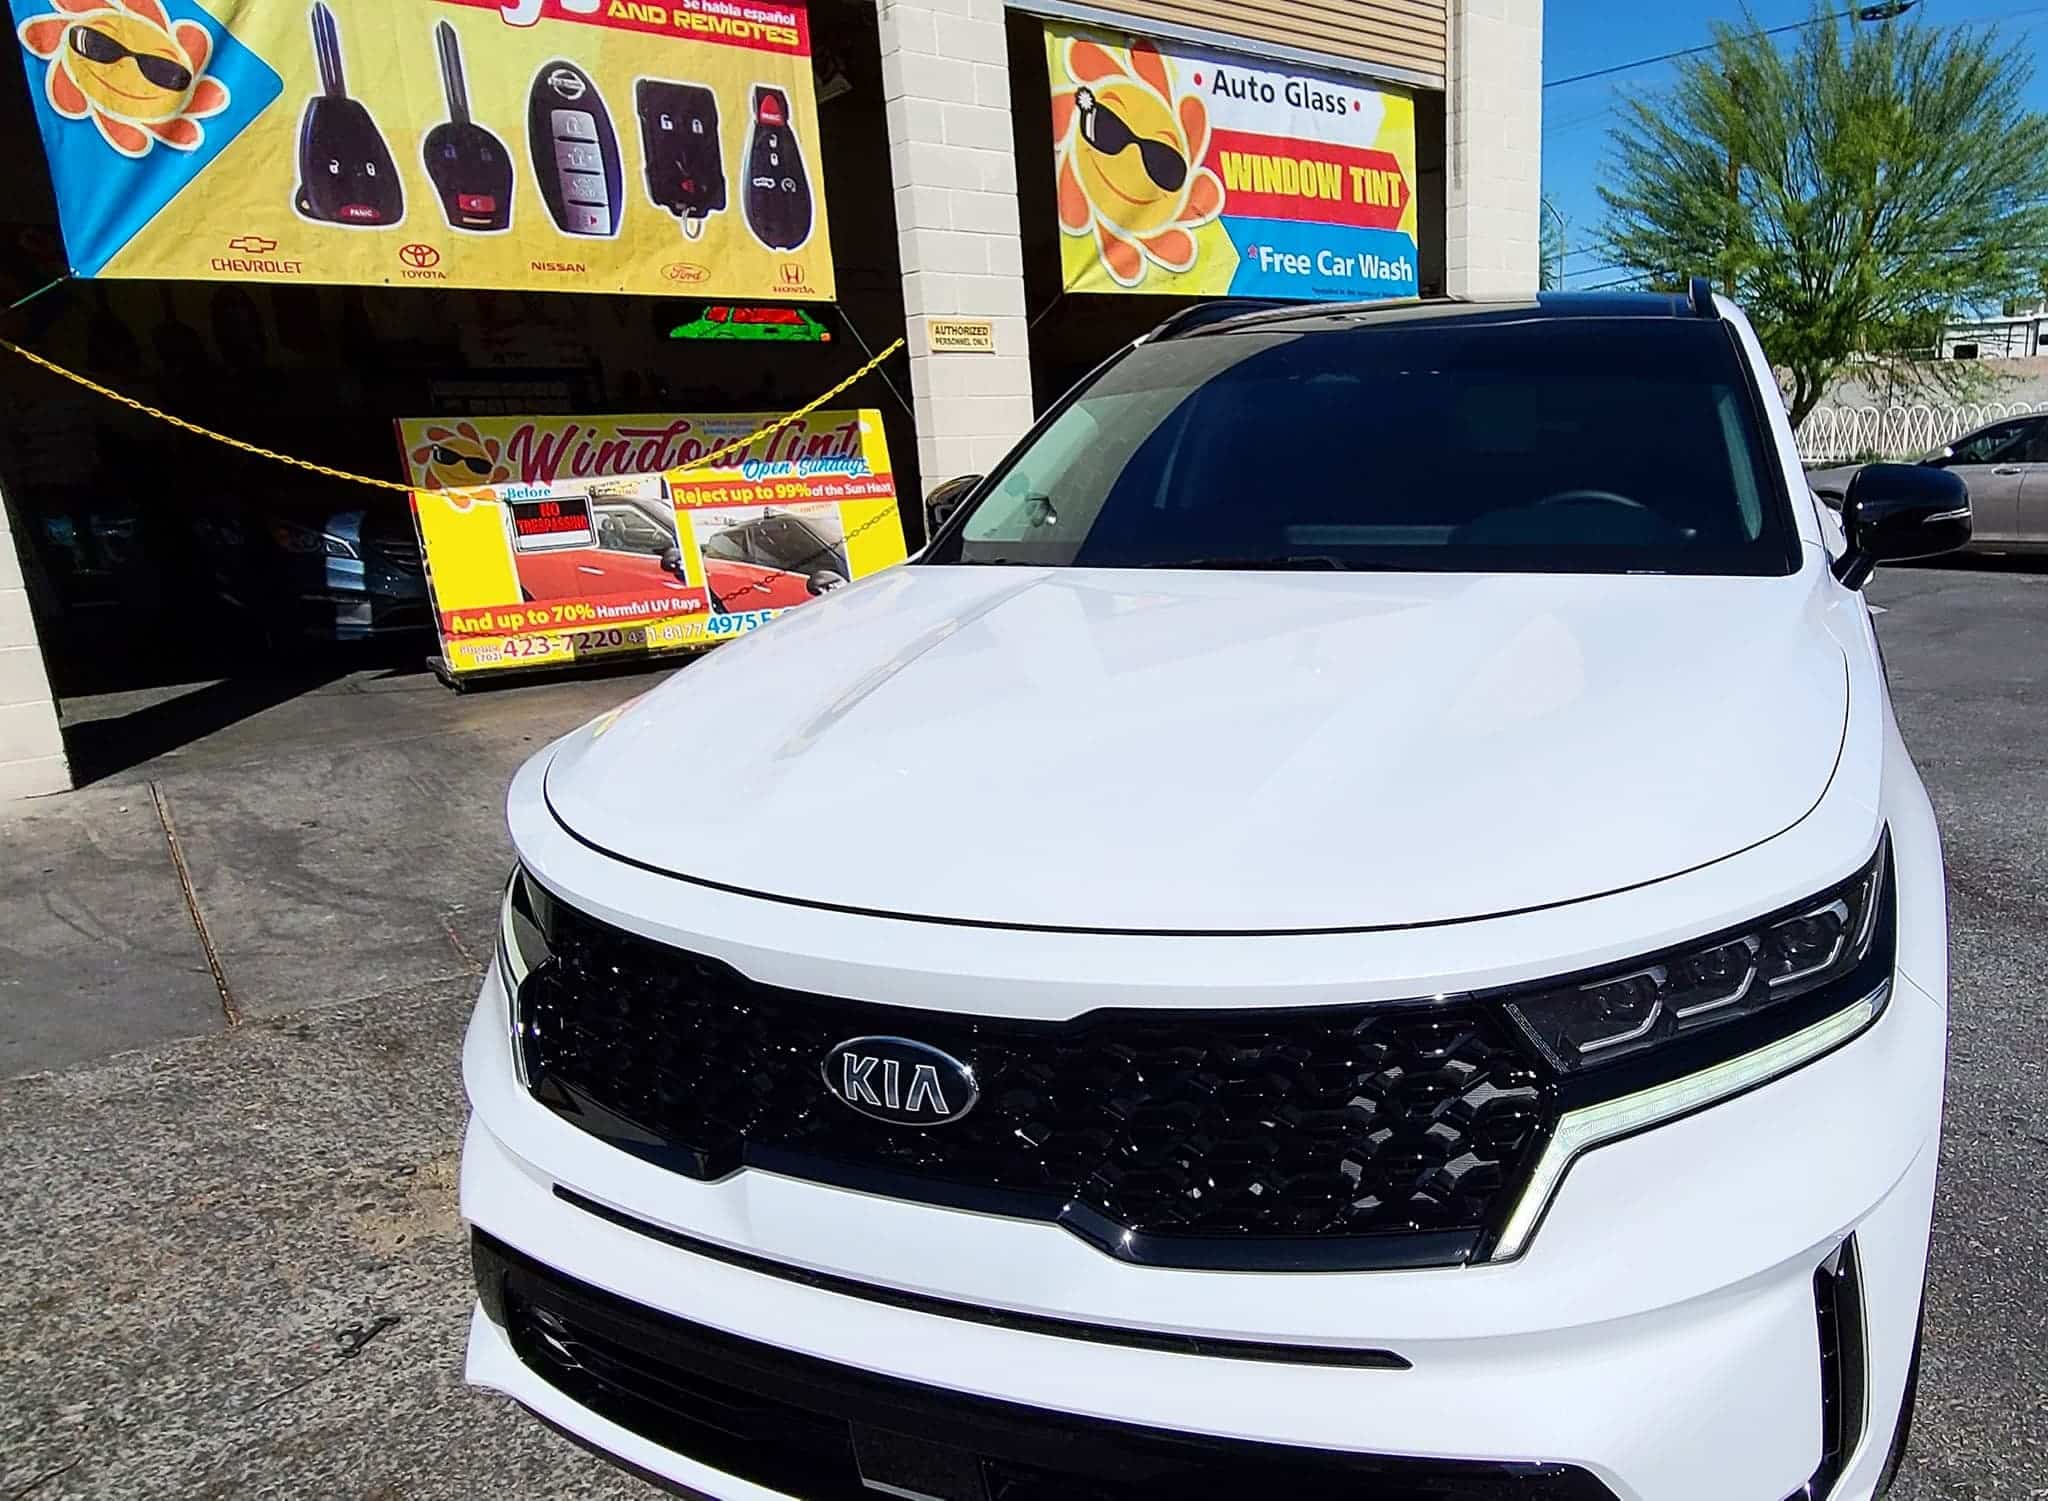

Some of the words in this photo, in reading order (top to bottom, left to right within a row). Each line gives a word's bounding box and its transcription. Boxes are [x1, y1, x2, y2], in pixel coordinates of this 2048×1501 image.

[607, 0, 667, 24] AND
[674, 12, 799, 46] REMOTES
[702, 0, 741, 16] habla
[743, 8, 796, 26] español
[1212, 70, 1275, 103] Auto
[1285, 81, 1347, 115] Glass
[1219, 151, 1342, 201] WINDOW
[1349, 166, 1401, 208] TINT
[211, 258, 303, 274] CHEVROLET
[401, 270, 447, 279] TOYOTA
[531, 262, 585, 273] NISSAN
[669, 266, 703, 281] Ford
[1259, 246, 1311, 275] Free
[1317, 250, 1355, 277] Car
[1358, 253, 1413, 282] Wash
[772, 285, 815, 294] HONDA
[935, 326, 989, 335] AUTHORIZED
[507, 420, 749, 487] Window
[763, 418, 862, 466] Tint
[743, 457, 791, 480] Open
[507, 487, 551, 498] Before
[674, 485, 727, 507] Reject
[731, 487, 752, 505] up
[757, 484, 774, 501] to
[776, 481, 812, 499] 99%
[812, 486, 823, 496] of
[825, 484, 842, 495] the
[844, 483, 864, 495] Sun
[867, 481, 892, 494] Heat
[538, 502, 560, 517] NO
[451, 612, 494, 635] And
[497, 613, 525, 631] up
[527, 608, 550, 626] to
[551, 603, 596, 623] 70%
[597, 602, 649, 618] Harmful
[651, 600, 669, 612] UV
[672, 598, 701, 610] Rays
[707, 613, 757, 635] 4975
[503, 628, 623, 657] 423-7220
[843, 1053, 950, 1115] KIA
